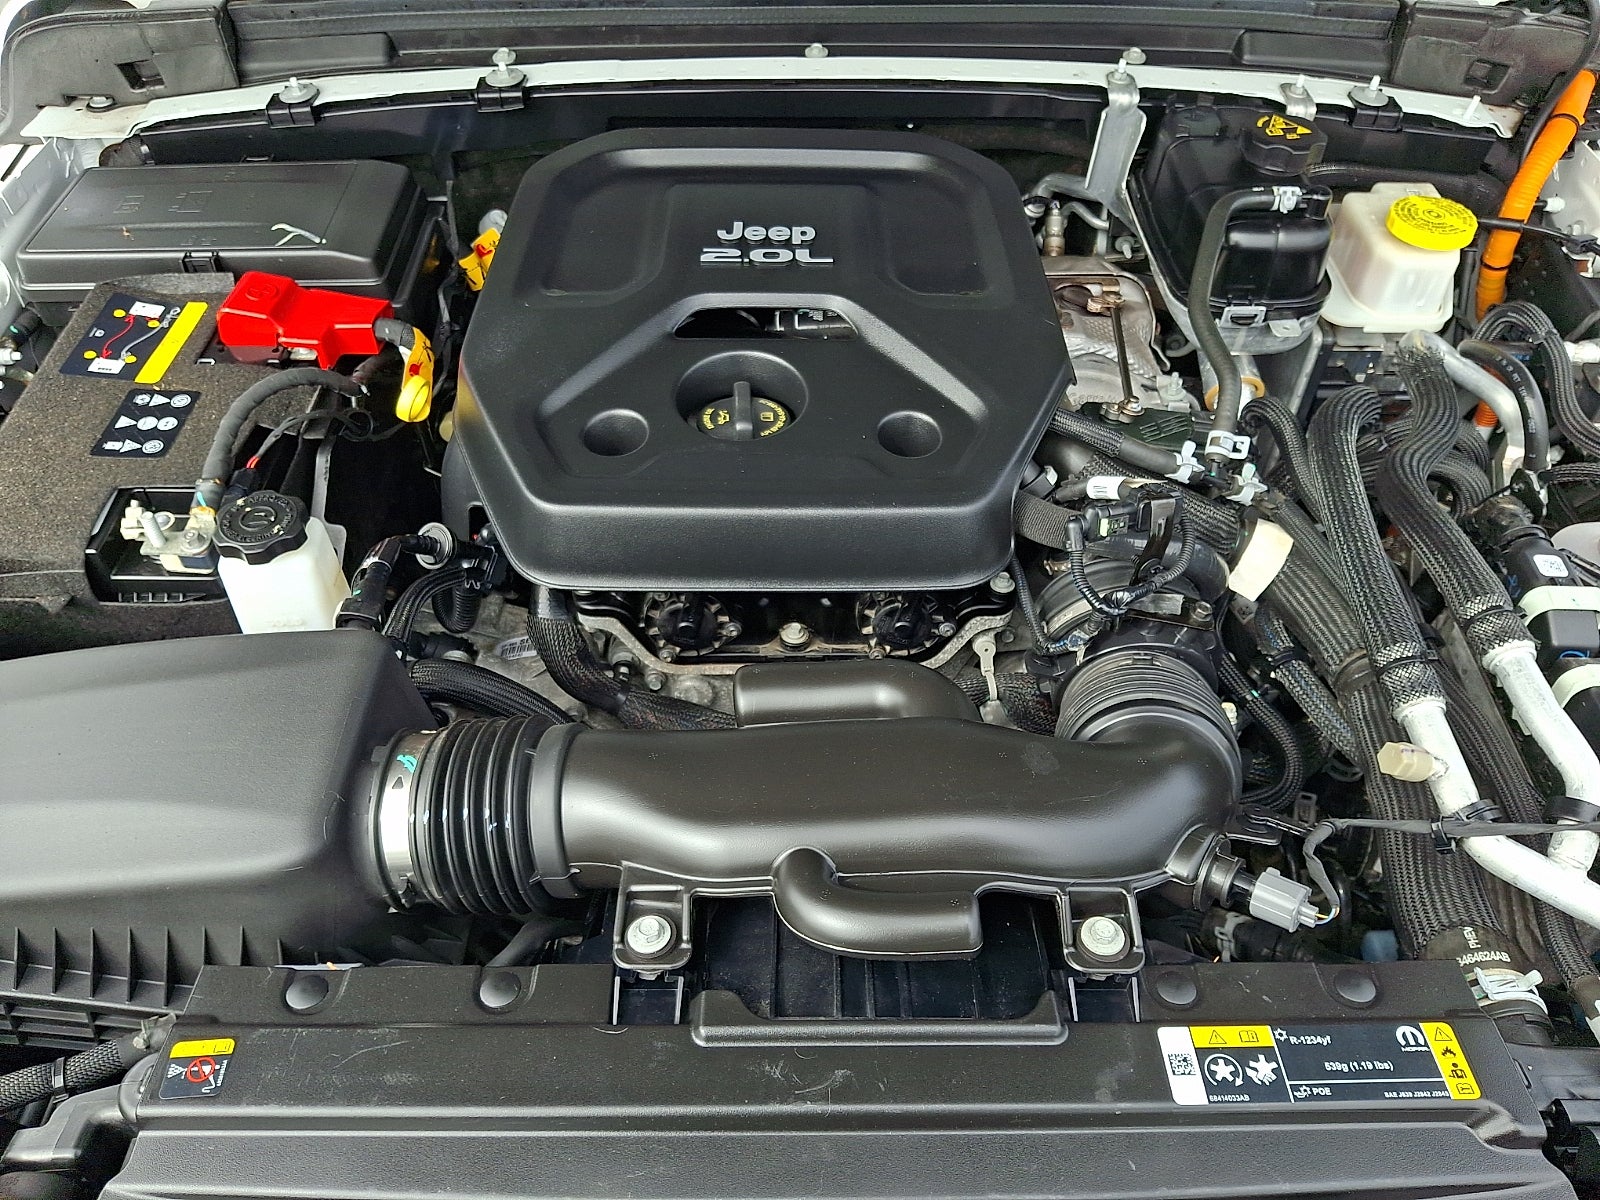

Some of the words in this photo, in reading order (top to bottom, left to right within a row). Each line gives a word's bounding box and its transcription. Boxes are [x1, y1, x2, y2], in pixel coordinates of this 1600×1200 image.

[716, 221, 816, 244] Jeep
[700, 248, 834, 263] 2.0L
[1464, 926, 1481, 948] PHEV
[1290, 1035, 1332, 1046] R-1234yf
[1350, 1061, 1373, 1072] (1.19
[1374, 1060, 1394, 1071] lbs)
[1312, 1087, 1332, 1096] POE
